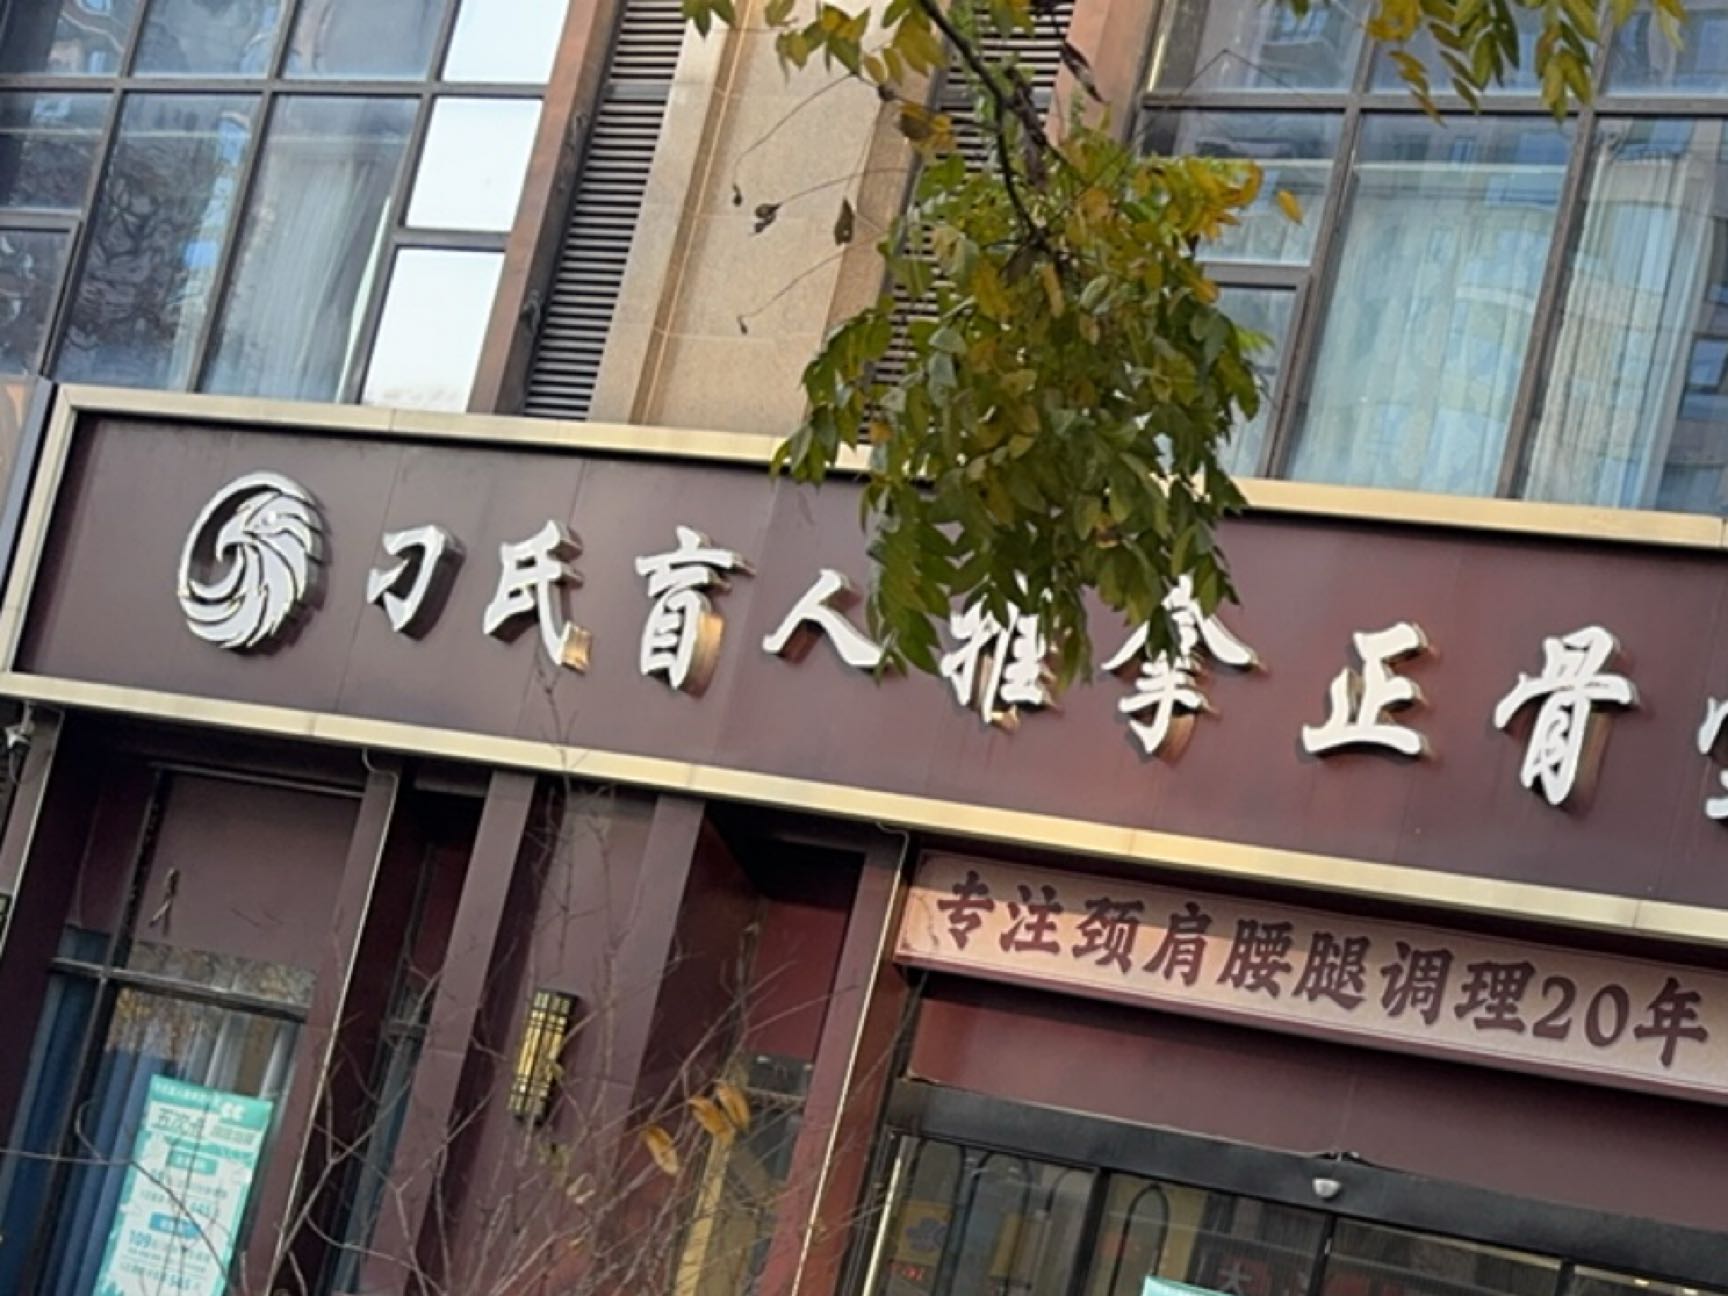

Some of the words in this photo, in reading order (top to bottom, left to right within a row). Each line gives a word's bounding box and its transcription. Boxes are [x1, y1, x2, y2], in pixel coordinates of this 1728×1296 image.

[936, 870, 1710, 1070] 专注颈肩腰腿调理20年
